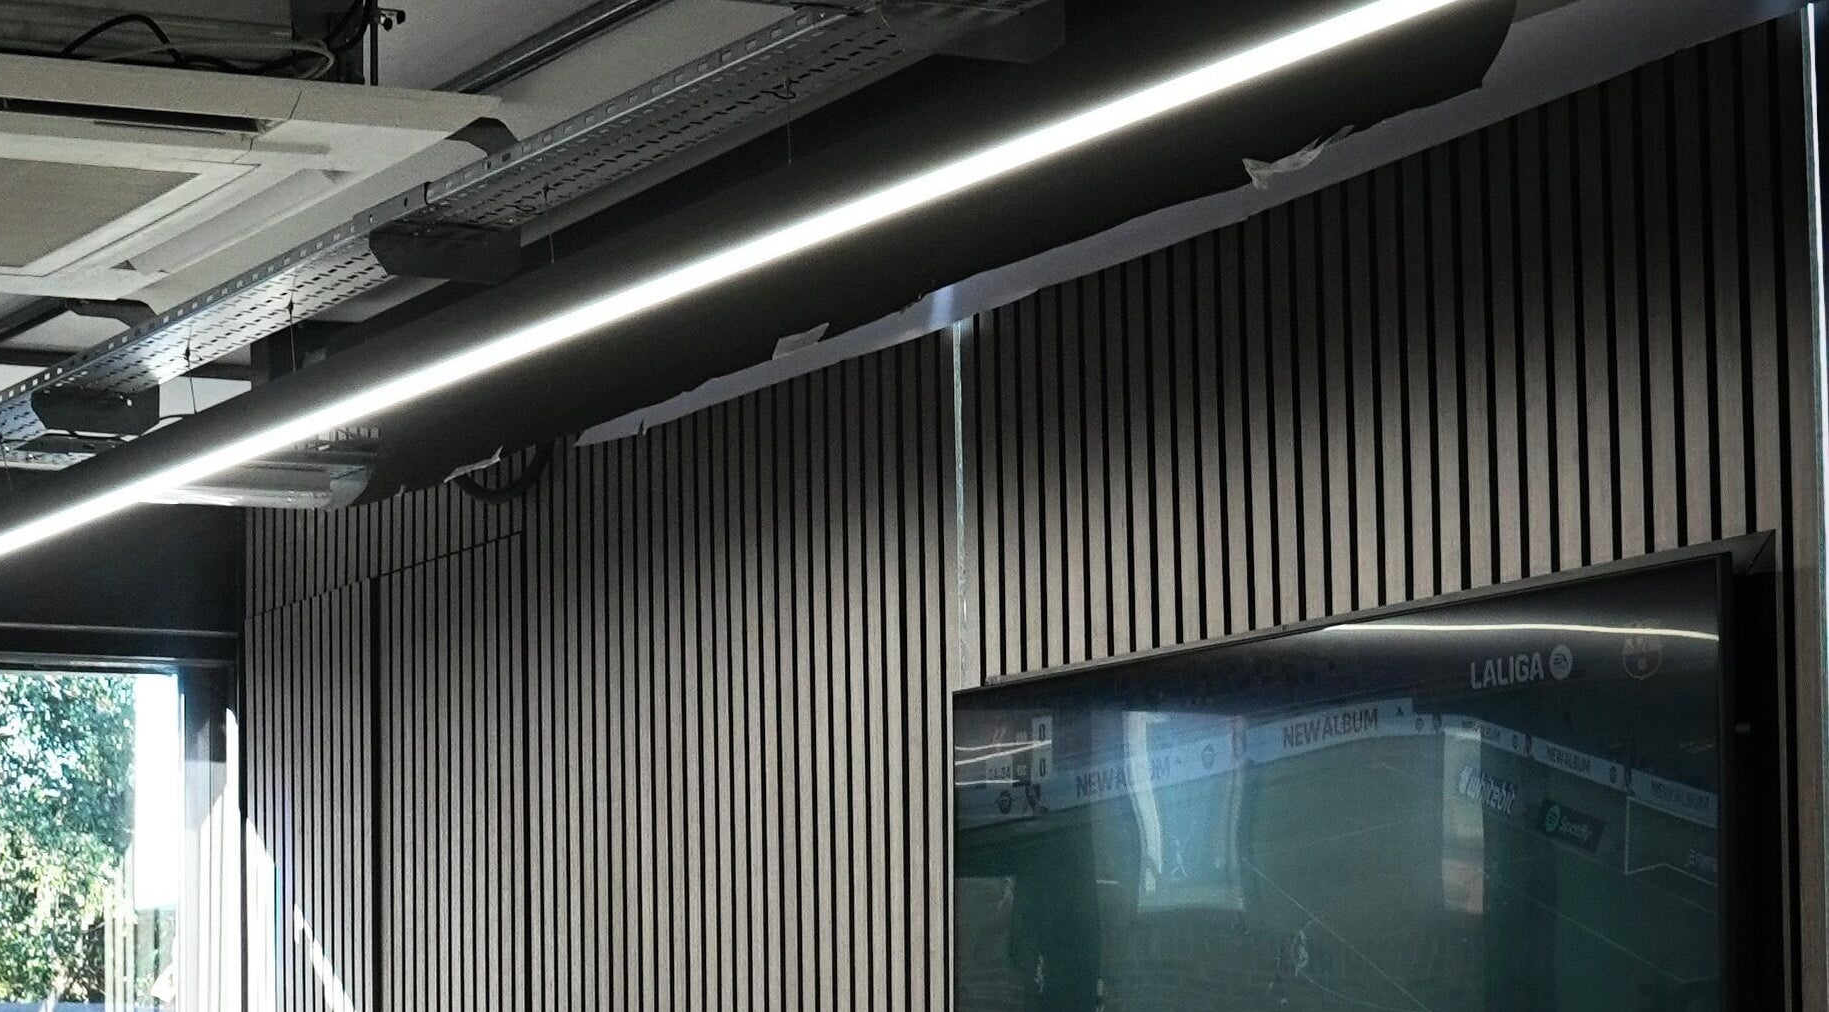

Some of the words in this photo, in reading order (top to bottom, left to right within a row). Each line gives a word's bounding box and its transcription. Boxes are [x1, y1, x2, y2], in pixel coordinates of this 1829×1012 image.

[1471, 653, 1545, 690] LALIGA
[1282, 718, 1320, 749] NEW
[1321, 708, 1379, 740] ALBUM
